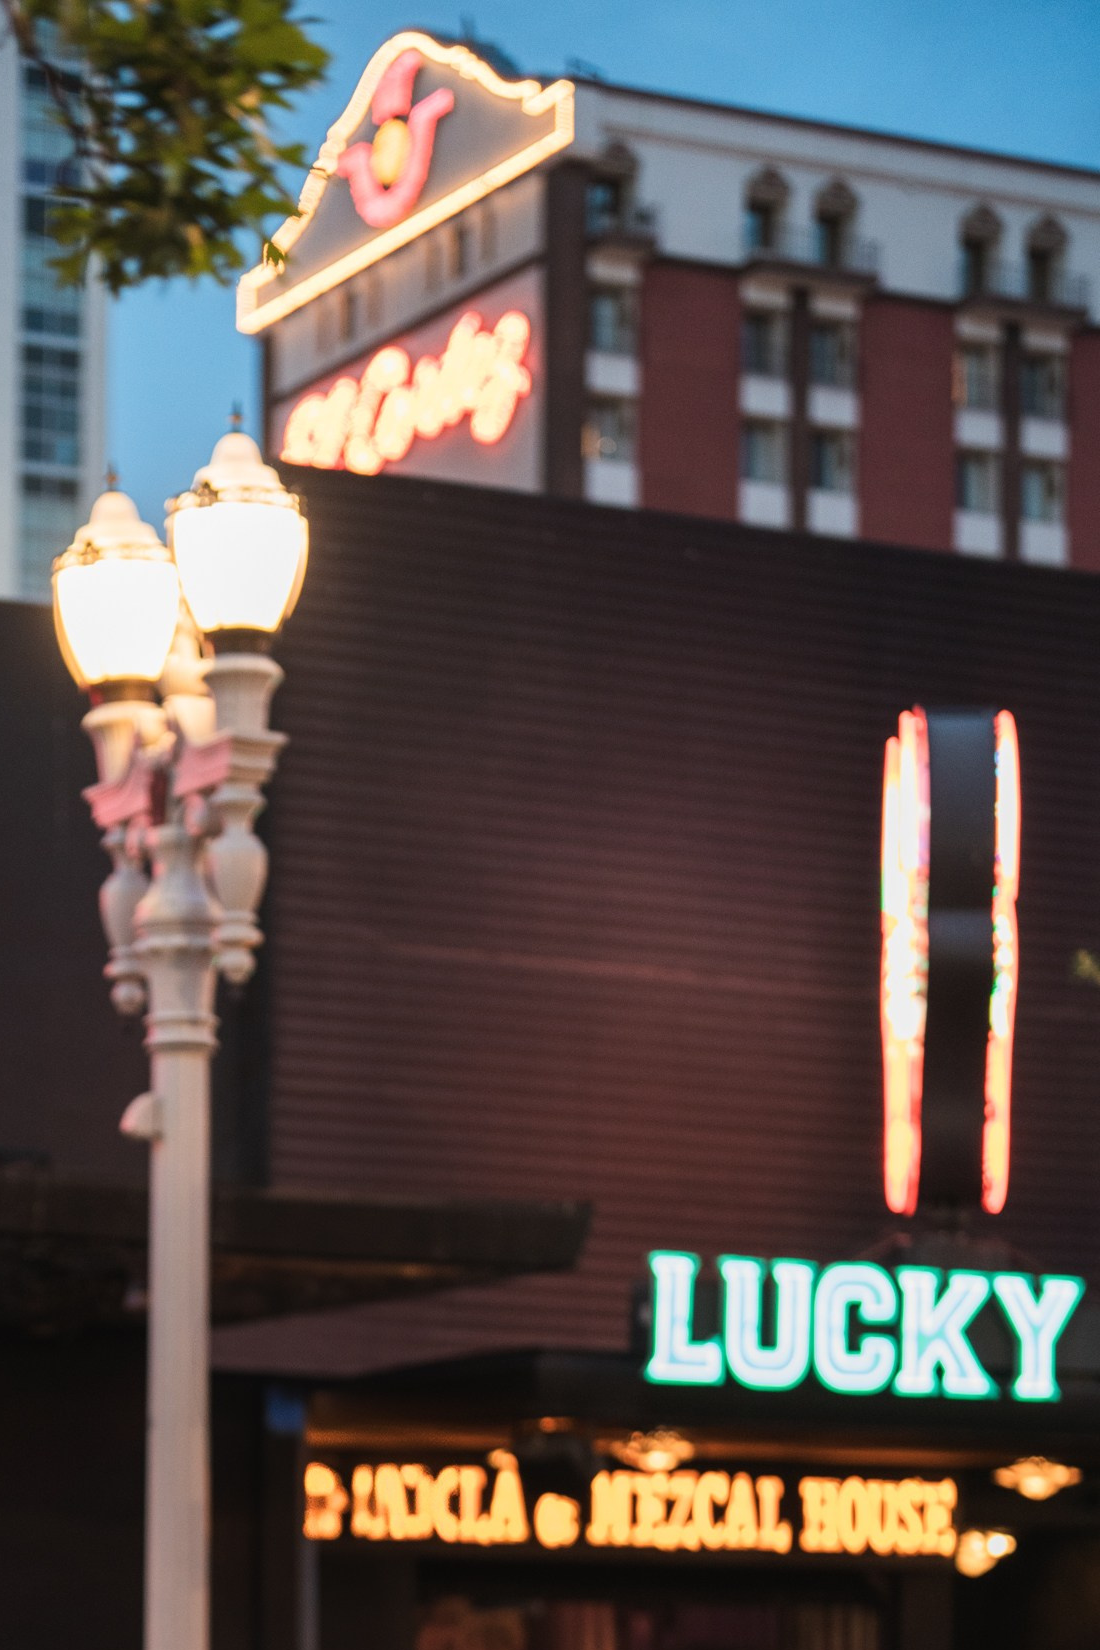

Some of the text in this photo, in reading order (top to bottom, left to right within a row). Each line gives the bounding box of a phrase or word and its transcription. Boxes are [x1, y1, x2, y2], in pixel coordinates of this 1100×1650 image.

[644, 1250, 1085, 1401] LUCKY
[586, 1470, 792, 1554] MEZCAL
[799, 1475, 957, 1557] HOUSE
